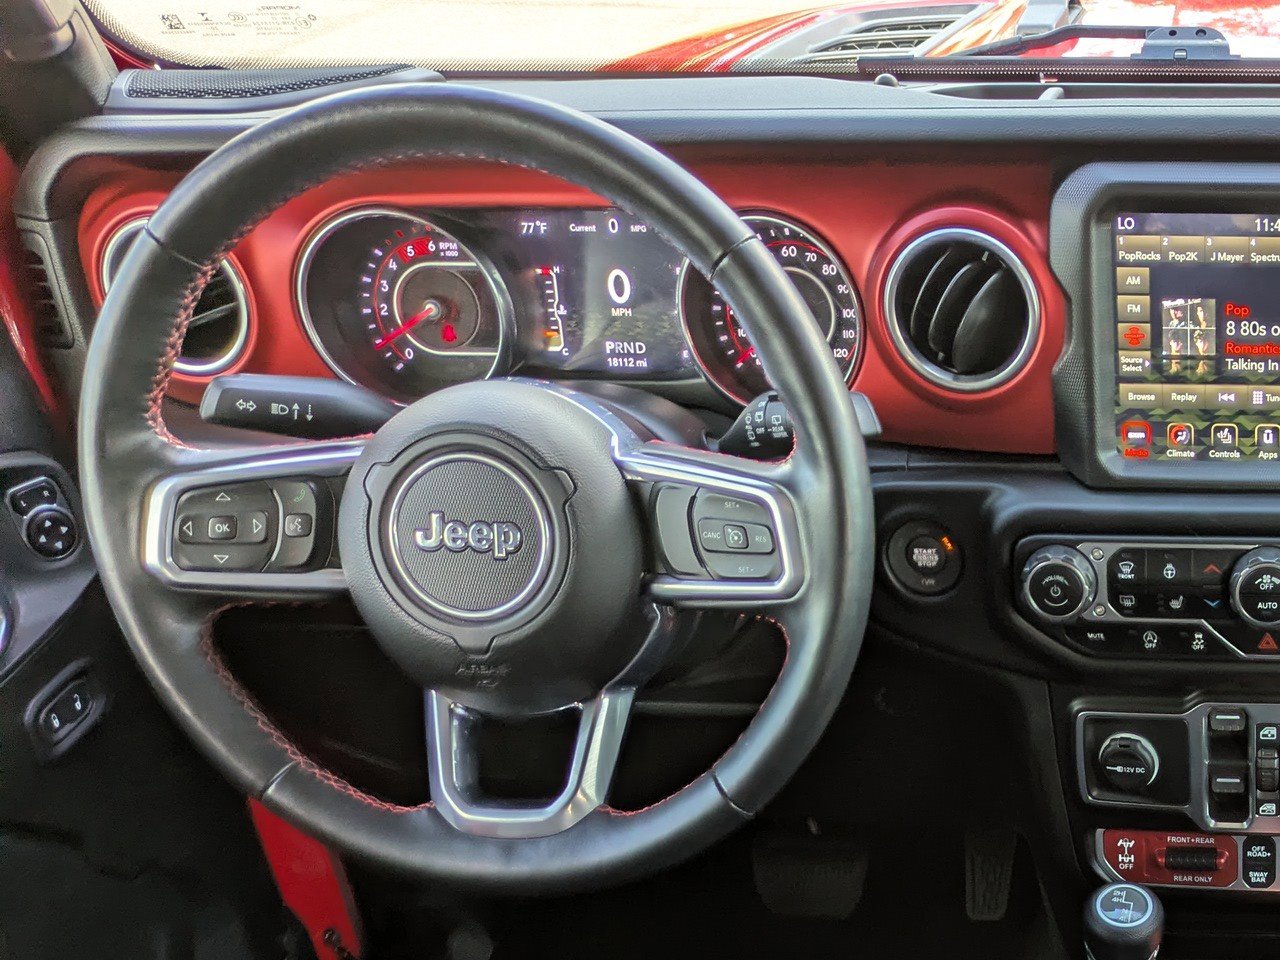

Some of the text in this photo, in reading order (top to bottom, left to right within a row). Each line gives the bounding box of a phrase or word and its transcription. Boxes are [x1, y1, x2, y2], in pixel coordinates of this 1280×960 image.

[569, 218, 647, 234] Current 0 MPG
[1117, 217, 1135, 230] LO
[428, 240, 436, 252] 6
[439, 242, 458, 250] RPM
[1118, 237, 1124, 245] 1
[1162, 238, 1168, 246] 2
[1206, 238, 1212, 246] 3
[1250, 239, 1256, 247] 4
[406, 245, 415, 257] 5
[781, 246, 797, 257] 60
[805, 252, 817, 262] 70
[1118, 251, 1161, 262] PopRocks
[1168, 251, 1198, 262] Pop2K
[1210, 252, 1244, 263] J Mayer
[388, 258, 397, 271] 4
[553, 266, 560, 274] H
[822, 264, 837, 276] 80
[1126, 276, 1141, 285] AM
[380, 280, 389, 292] 3
[607, 268, 631, 304] 0
[837, 284, 849, 294] 90
[380, 304, 388, 316] 2
[611, 307, 632, 316] MPH
[842, 309, 856, 318] 100
[1127, 304, 1141, 313] FM
[1225, 304, 1249, 316] Pop
[1226, 320, 1236, 336] 8
[1240, 321, 1266, 336] 80s
[842, 330, 855, 338] 110
[562, 348, 569, 356] C
[605, 341, 646, 354] PRND
[405, 348, 414, 359] 0
[833, 348, 849, 358] 120
[607, 357, 648, 367] 18112 mi
[1120, 356, 1143, 364] Source
[1122, 364, 1142, 373] Select
[1225, 359, 1265, 373] Talking
[1268, 359, 1279, 371] In
[1128, 392, 1155, 401] Browse
[1171, 393, 1197, 402] Replay
[1166, 449, 1195, 458] Climate
[1209, 450, 1240, 458] Controls
[1258, 450, 1278, 460] Apps
[215, 523, 229, 533] OK
[414, 509, 524, 560] Jeep
[702, 531, 721, 539] CANC
[755, 535, 767, 543] RES
[1044, 574, 1067, 583] VOLUME
[1087, 632, 1105, 640] MUTE
